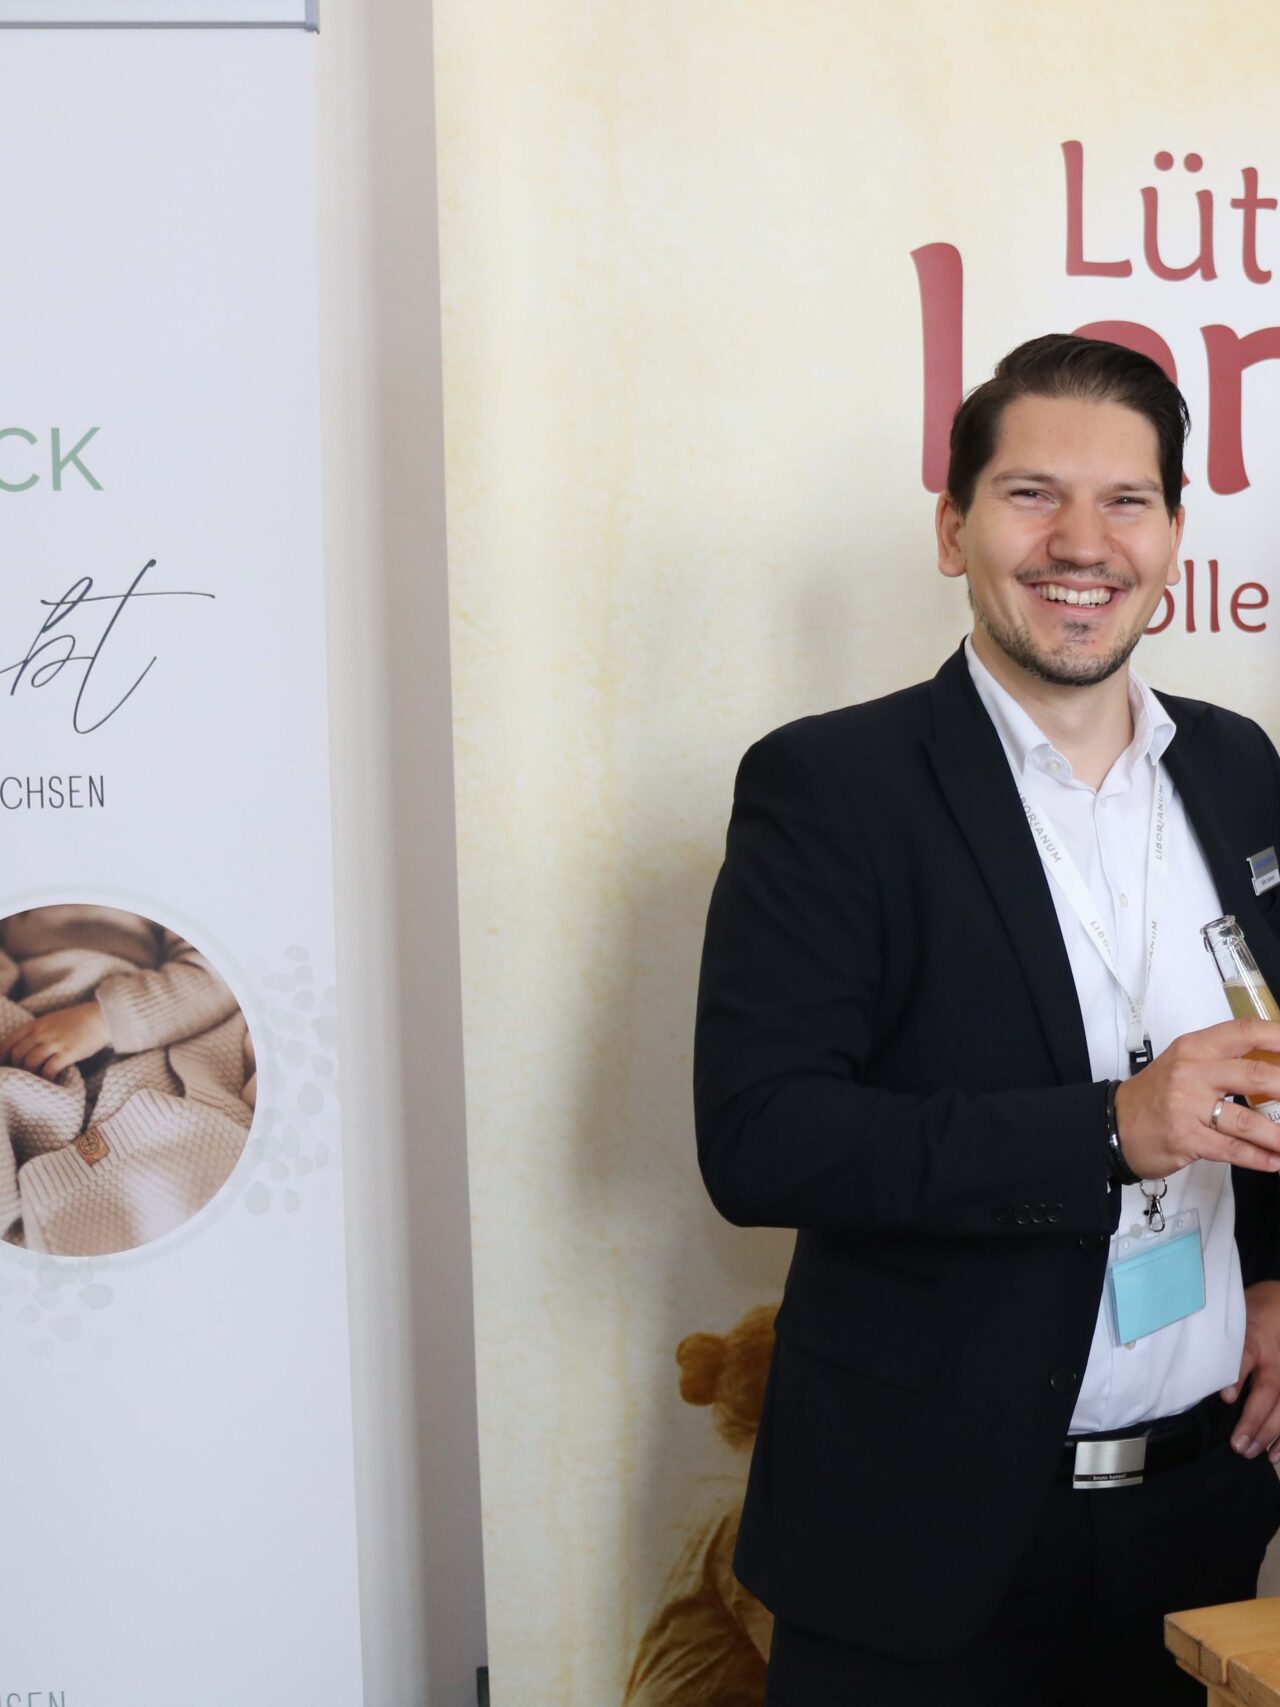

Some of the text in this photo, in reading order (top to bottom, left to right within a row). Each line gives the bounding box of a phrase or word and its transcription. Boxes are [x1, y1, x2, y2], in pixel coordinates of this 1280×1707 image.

[1142, 559, 1269, 635] olle
[0, 775, 105, 810] CHSEN
[1155, 784, 1165, 861] LIBORIANUM
